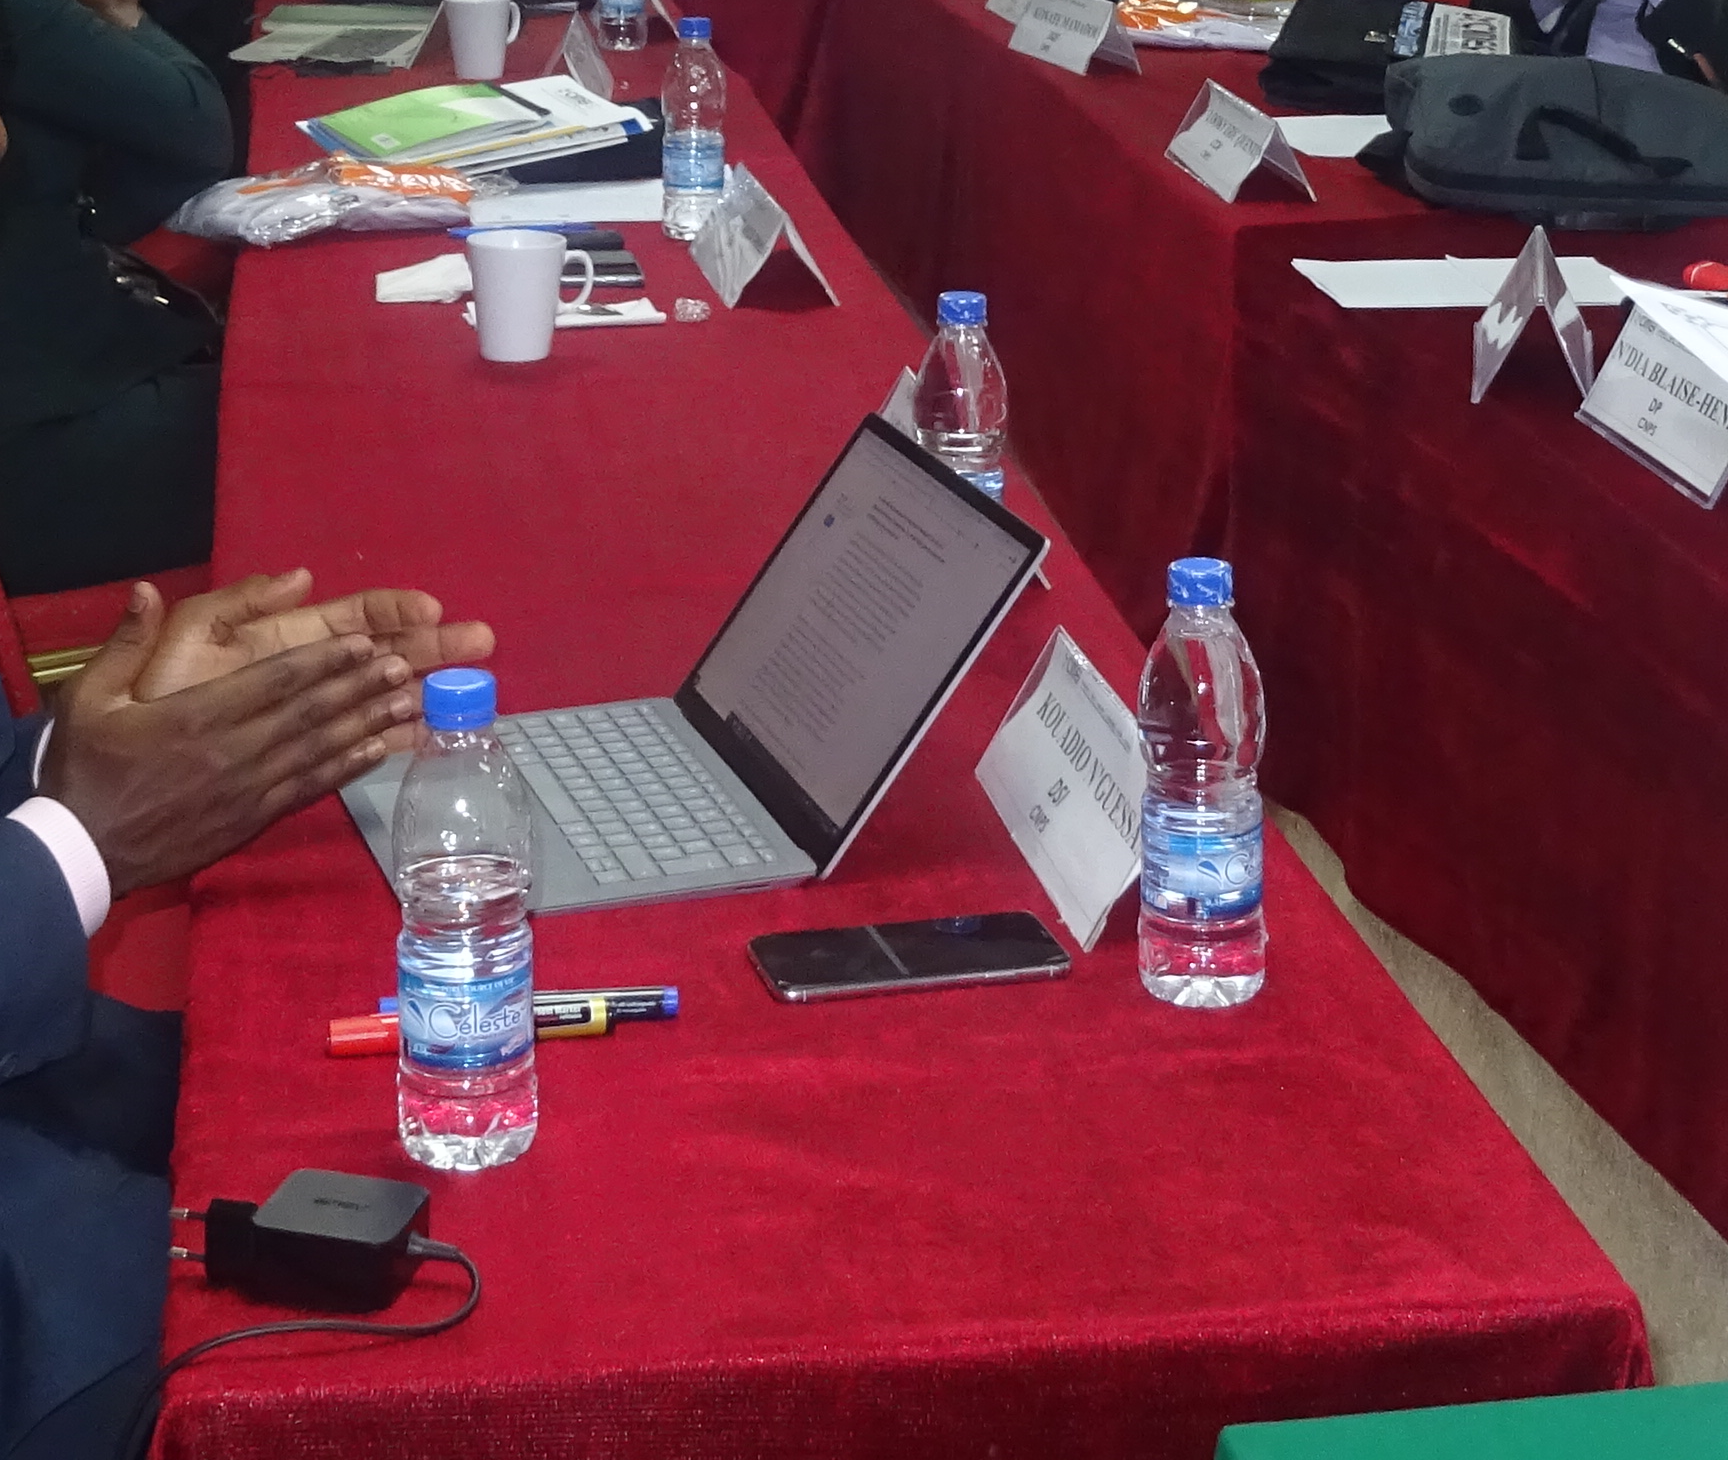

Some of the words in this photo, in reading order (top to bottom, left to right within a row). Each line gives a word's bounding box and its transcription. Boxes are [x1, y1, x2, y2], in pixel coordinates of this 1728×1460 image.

[1648, 398, 1663, 413] DP
[1035, 691, 1092, 773] KOUADIO
[1087, 756, 1141, 856] N'GUESSA
[1047, 777, 1071, 807] DSI
[428, 1001, 522, 1040] Céleste
